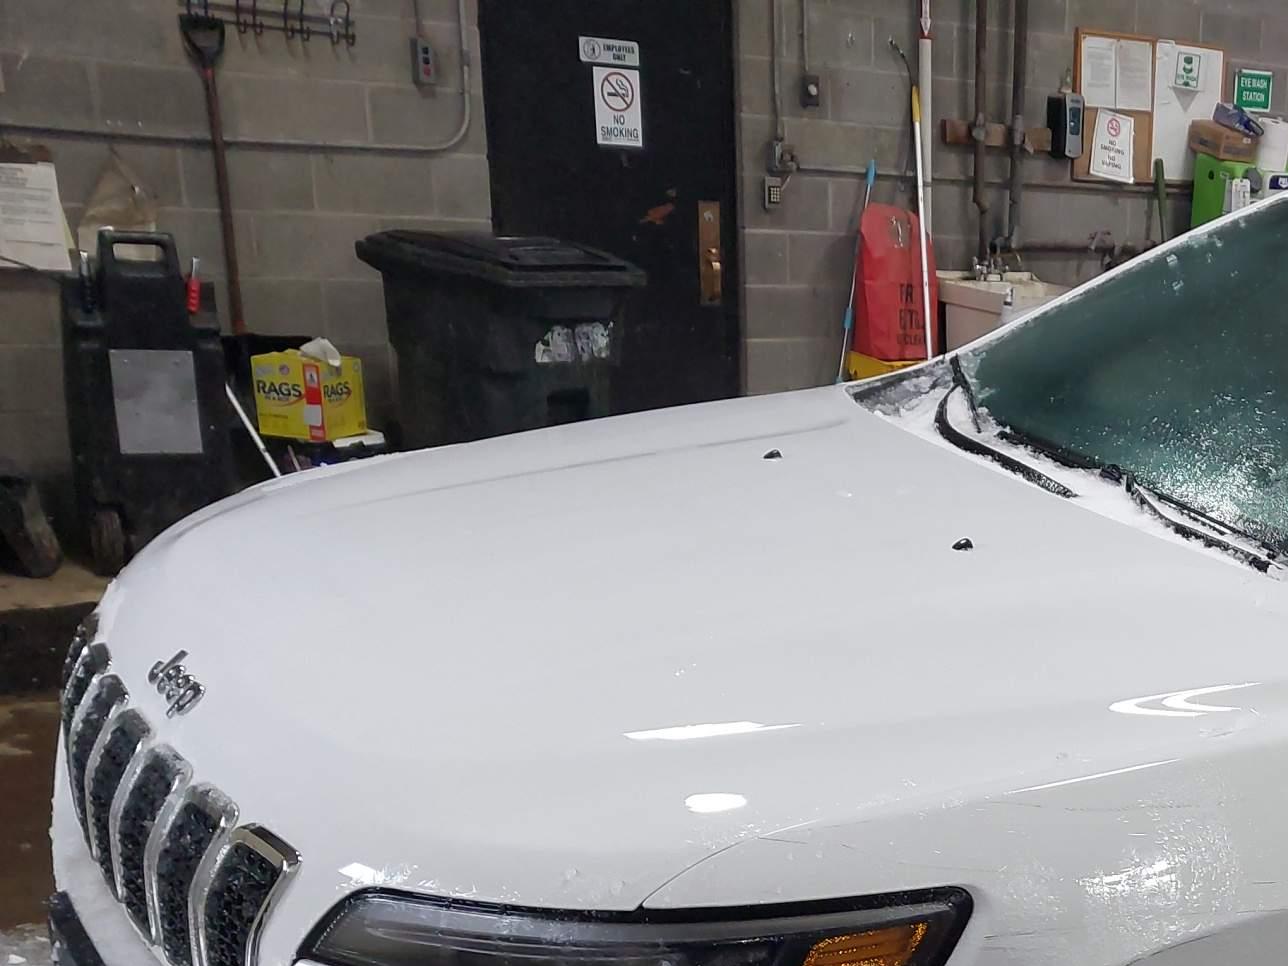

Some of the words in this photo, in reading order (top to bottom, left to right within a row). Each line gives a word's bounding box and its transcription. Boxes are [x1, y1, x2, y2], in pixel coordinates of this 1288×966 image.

[603, 44, 635, 54] EMPLOYEES
[613, 53, 626, 61] ONLY
[1242, 91, 1265, 102] STATION
[613, 115, 626, 127] NO
[600, 126, 640, 139] SMOKING
[256, 379, 303, 398] RAGS
[324, 381, 350, 398] RAGS
